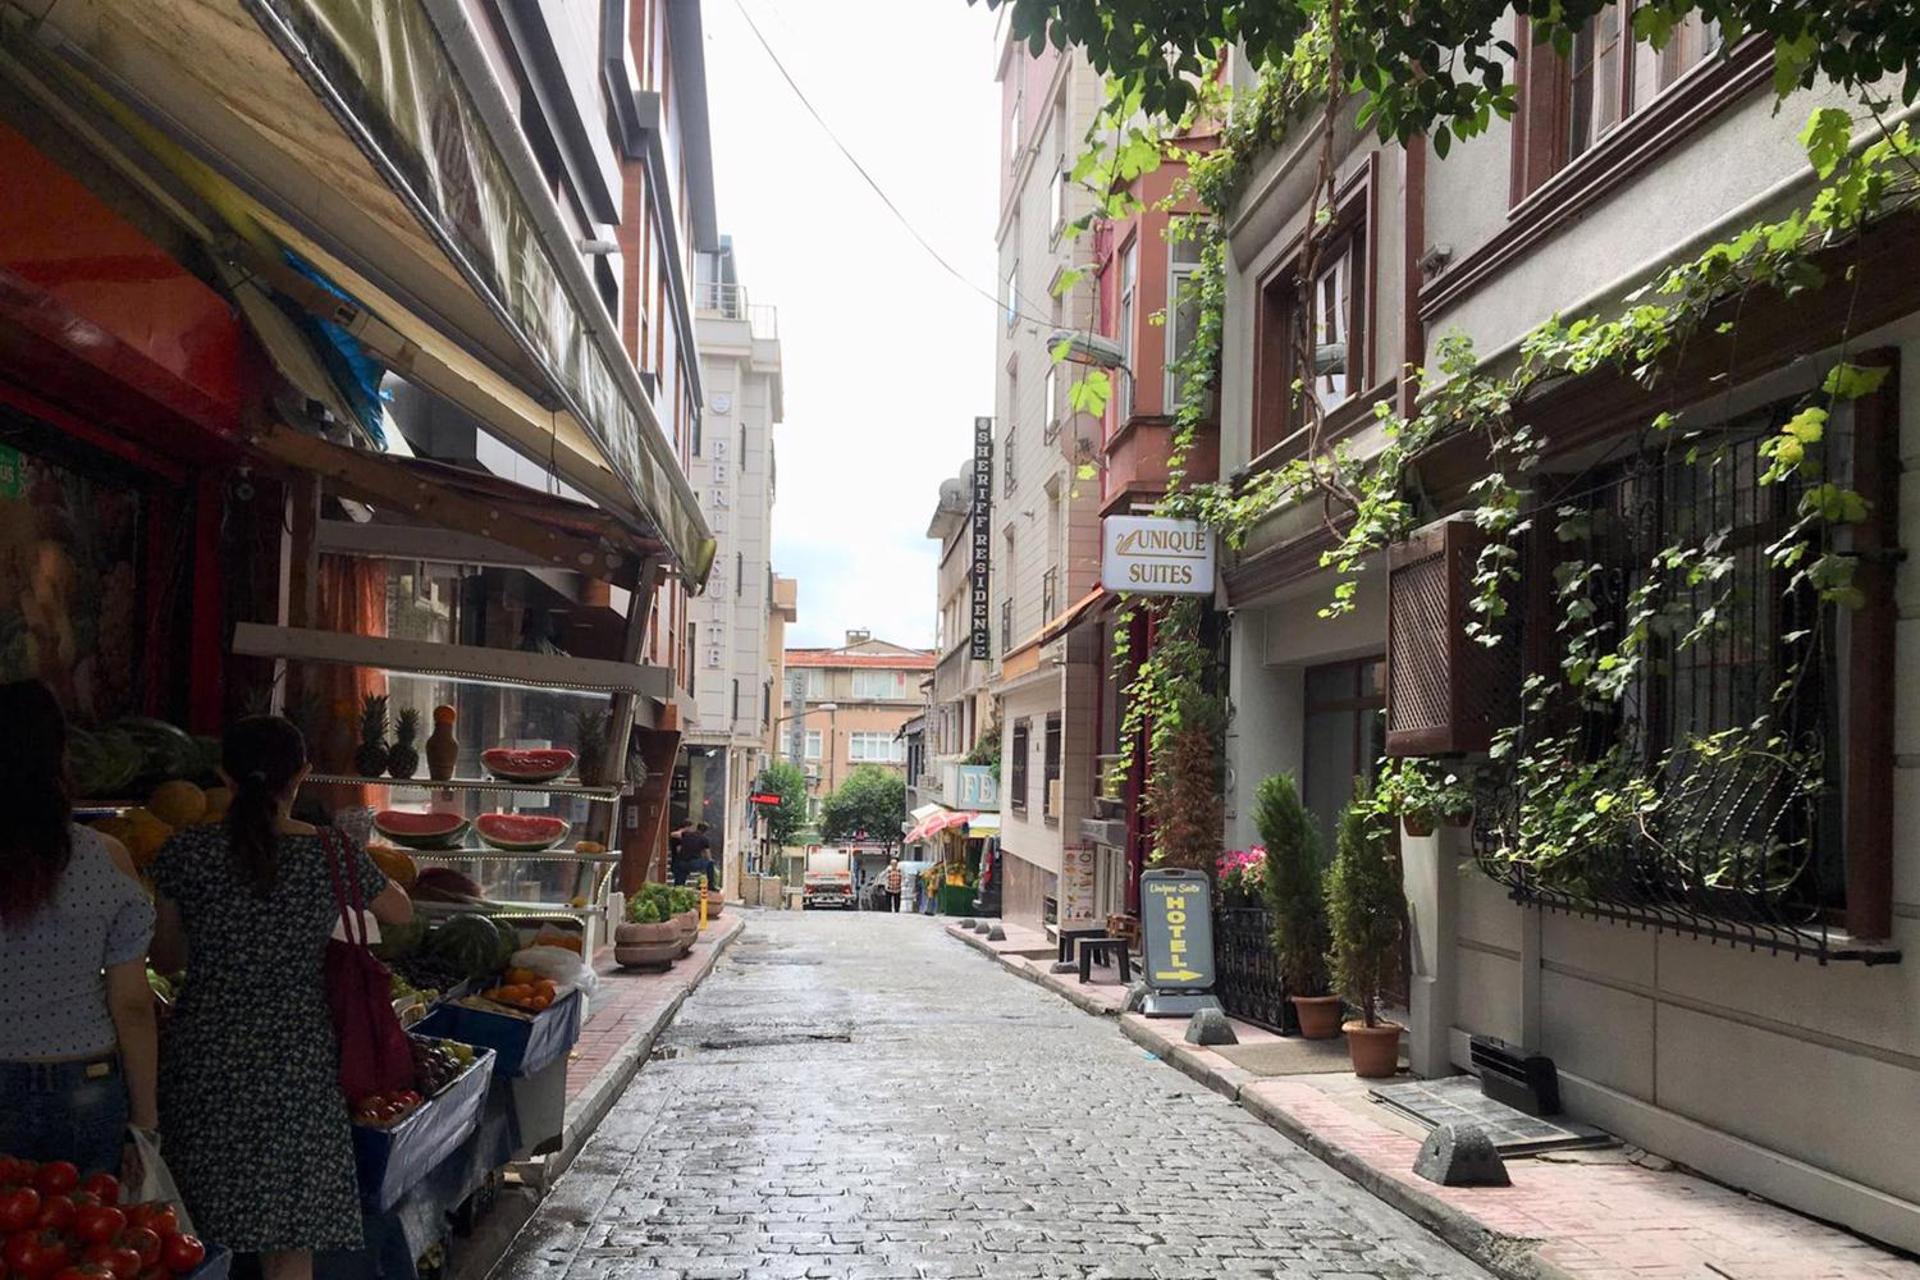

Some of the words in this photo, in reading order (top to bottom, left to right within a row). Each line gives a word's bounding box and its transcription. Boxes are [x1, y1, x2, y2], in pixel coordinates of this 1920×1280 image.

[976, 432, 990, 528] SHERIFF
[1128, 564, 1193, 585] SUITES
[1137, 530, 1207, 554] UNIQUE
[973, 536, 989, 657] RESIDENCE
[1166, 896, 1188, 969] HOTEL
